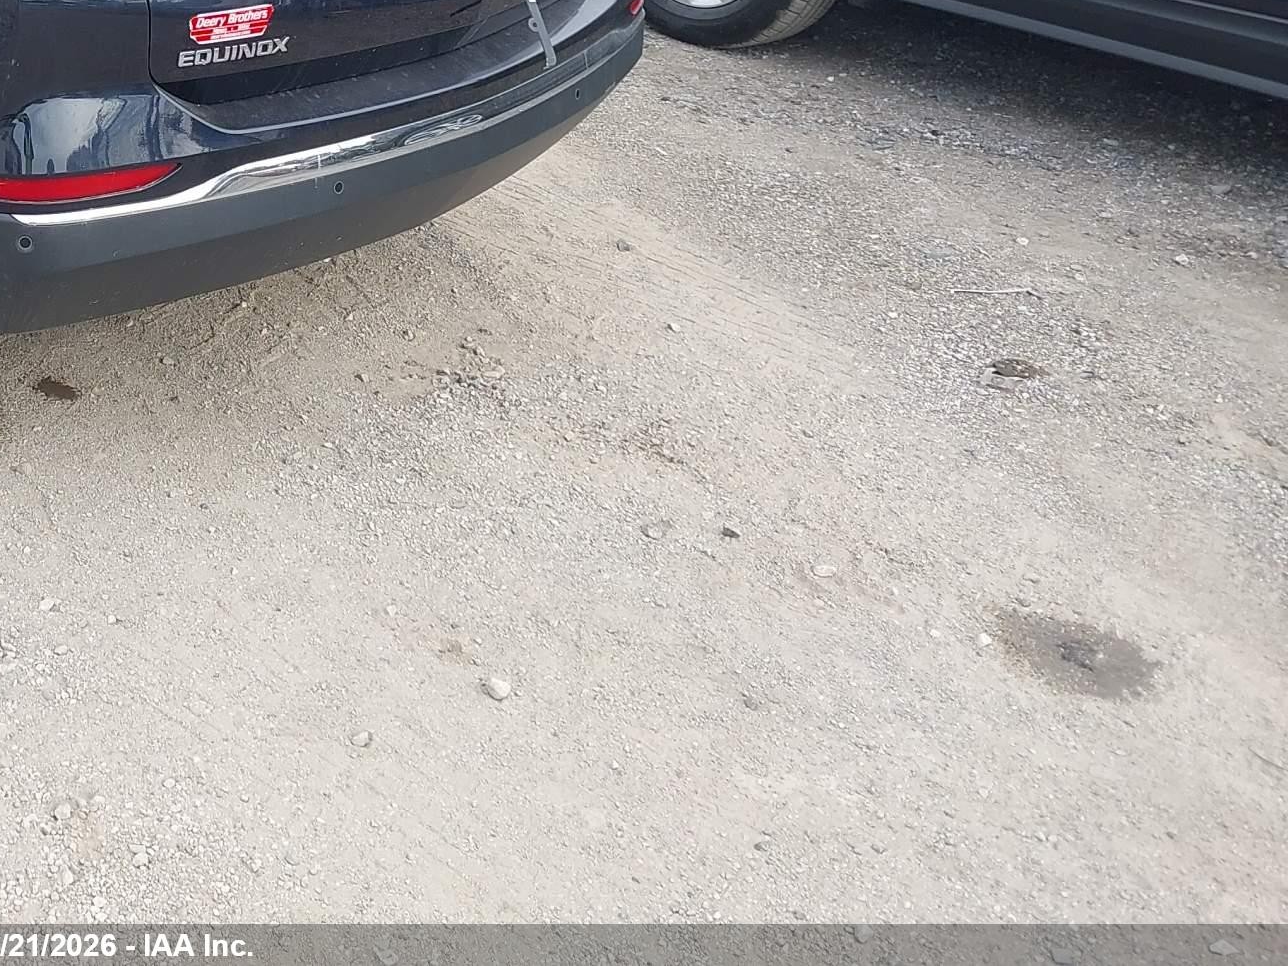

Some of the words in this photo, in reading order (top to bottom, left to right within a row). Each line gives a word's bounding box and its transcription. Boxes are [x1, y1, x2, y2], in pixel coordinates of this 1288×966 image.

[196, 16, 227, 28] Deery
[227, 10, 268, 23] Brothers
[177, 36, 290, 67] EQUINOX
